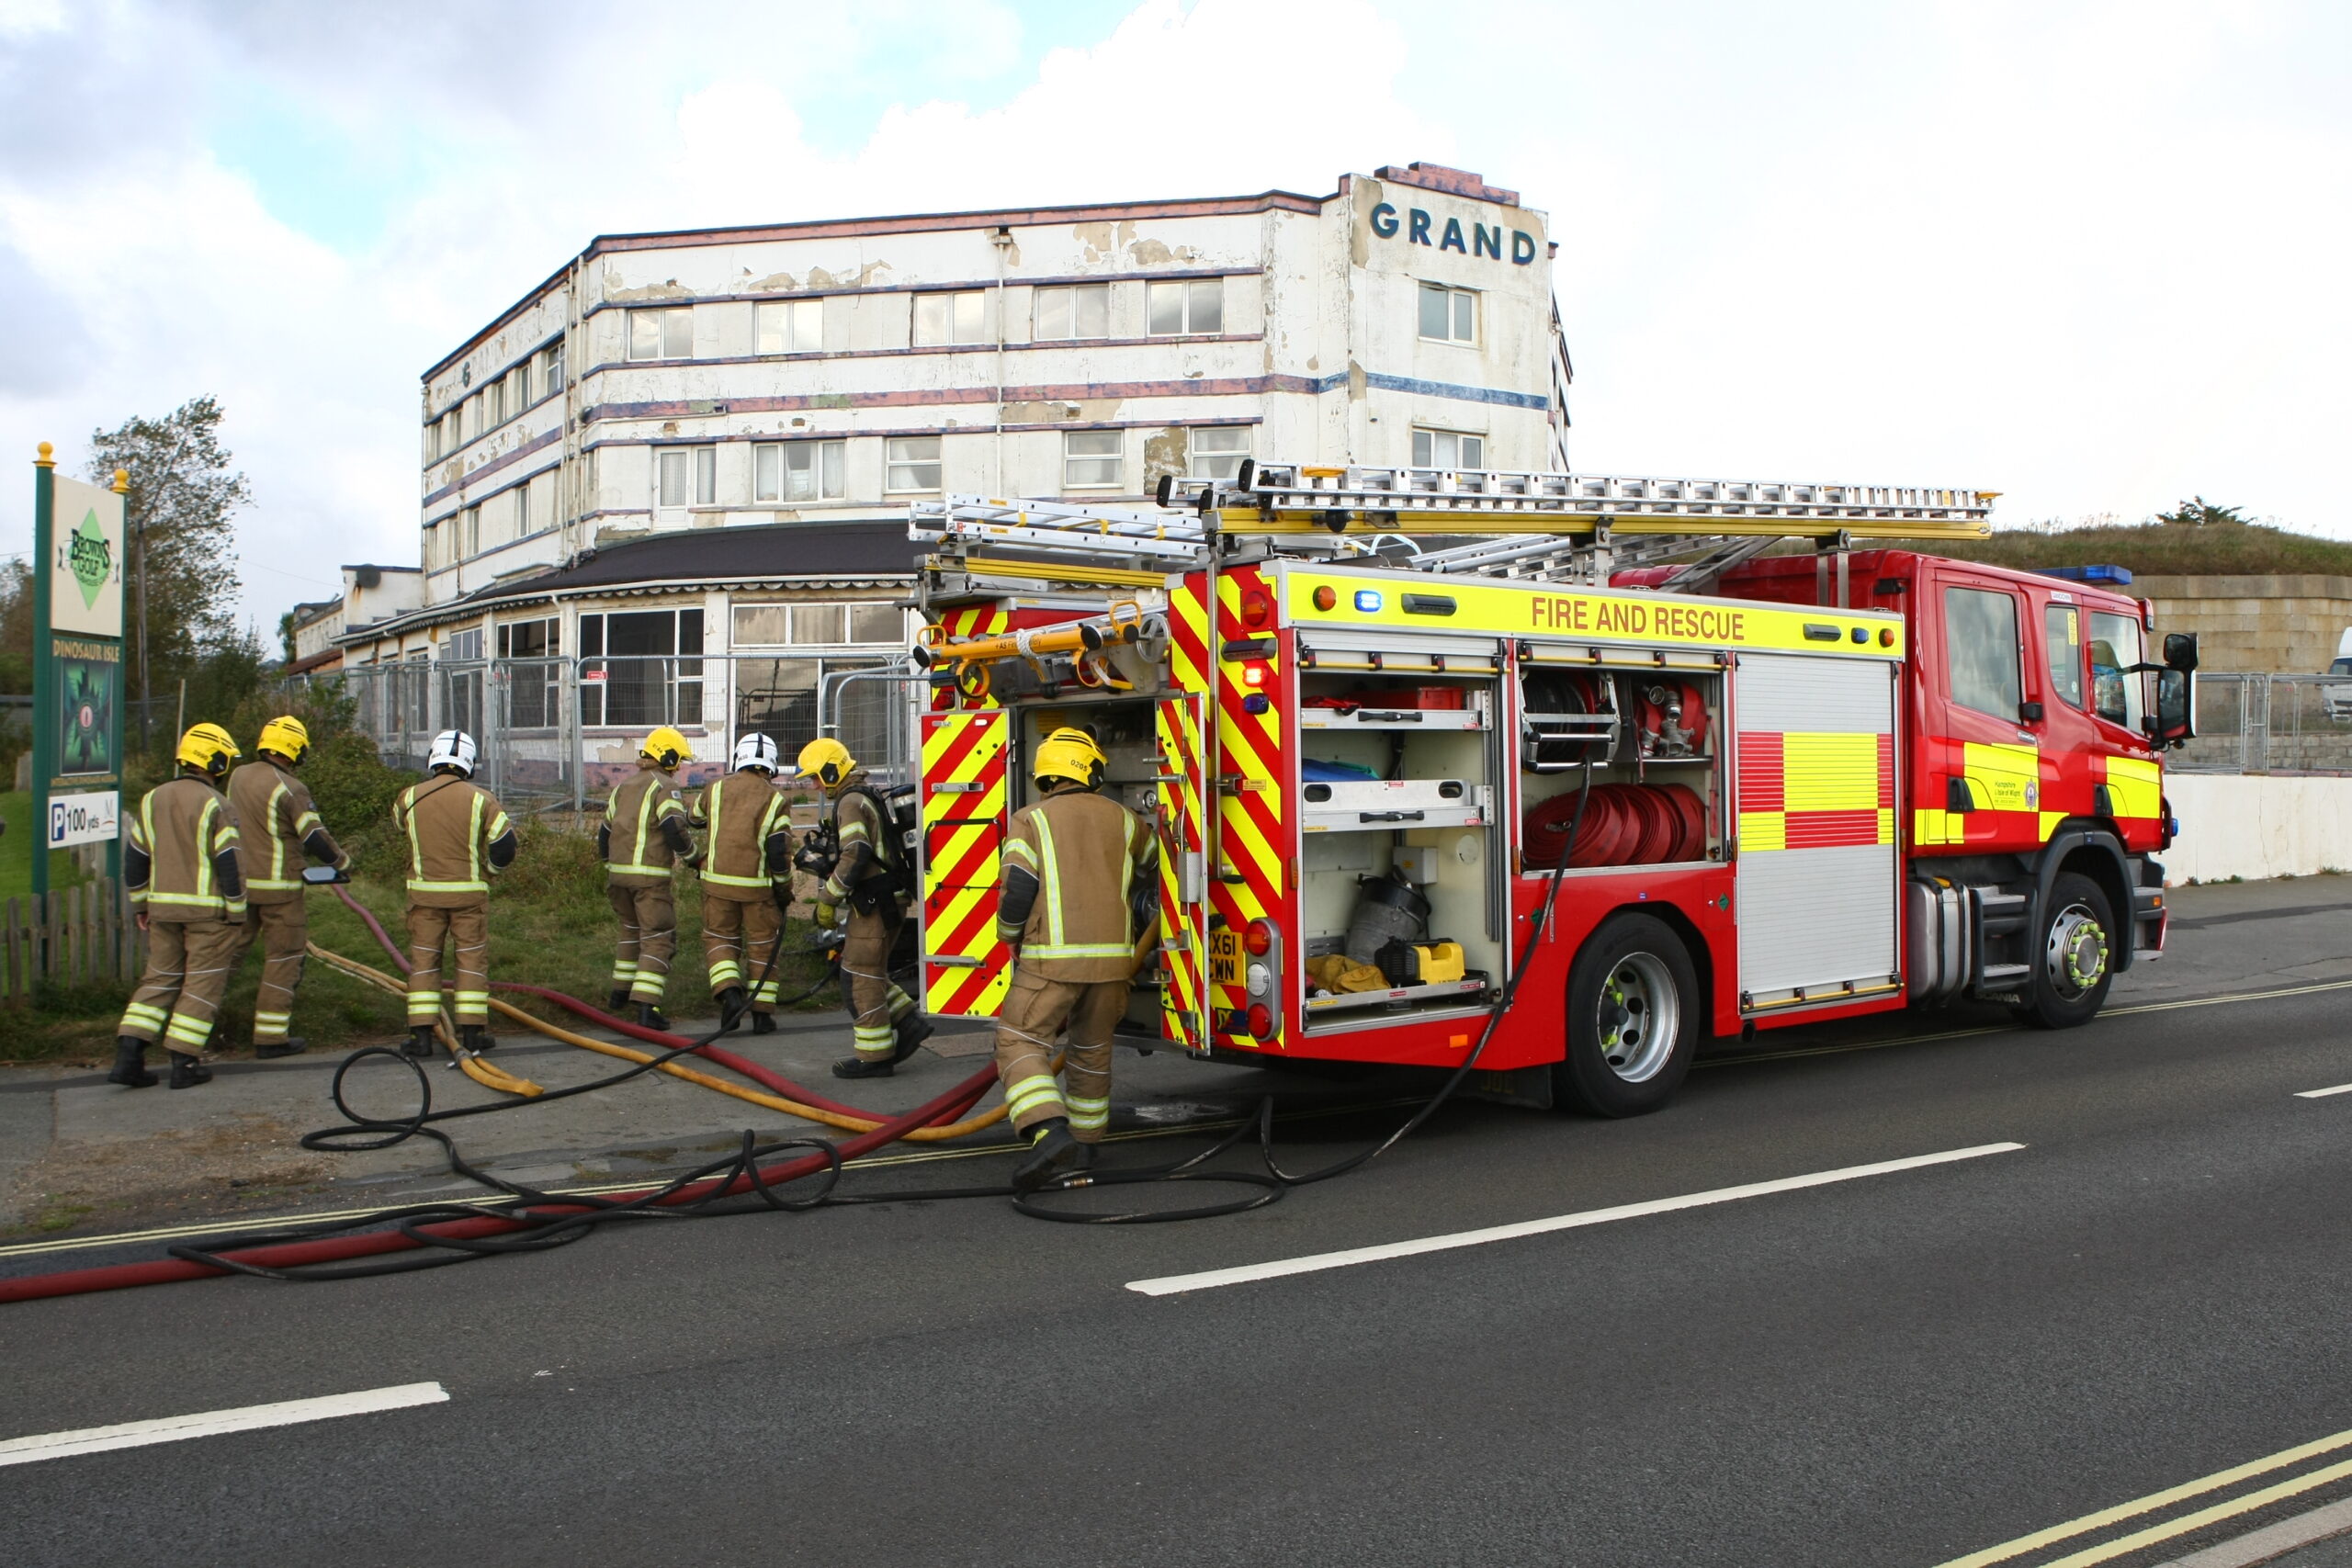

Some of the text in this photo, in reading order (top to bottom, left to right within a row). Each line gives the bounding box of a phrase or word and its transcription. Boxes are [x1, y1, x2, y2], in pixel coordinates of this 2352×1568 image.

[1370, 202, 1536, 266] GRAND
[78, 556, 99, 577] GOLF
[1532, 596, 1745, 641] FIRE AND RESCUE
[52, 638, 120, 663] DINOSAUR ISLE
[1070, 759, 1088, 772] 0205
[67, 807, 86, 833] 100
[86, 814, 100, 834] yds
[1208, 932, 1236, 956] X61
[1974, 991, 2021, 1004] SCANIA
